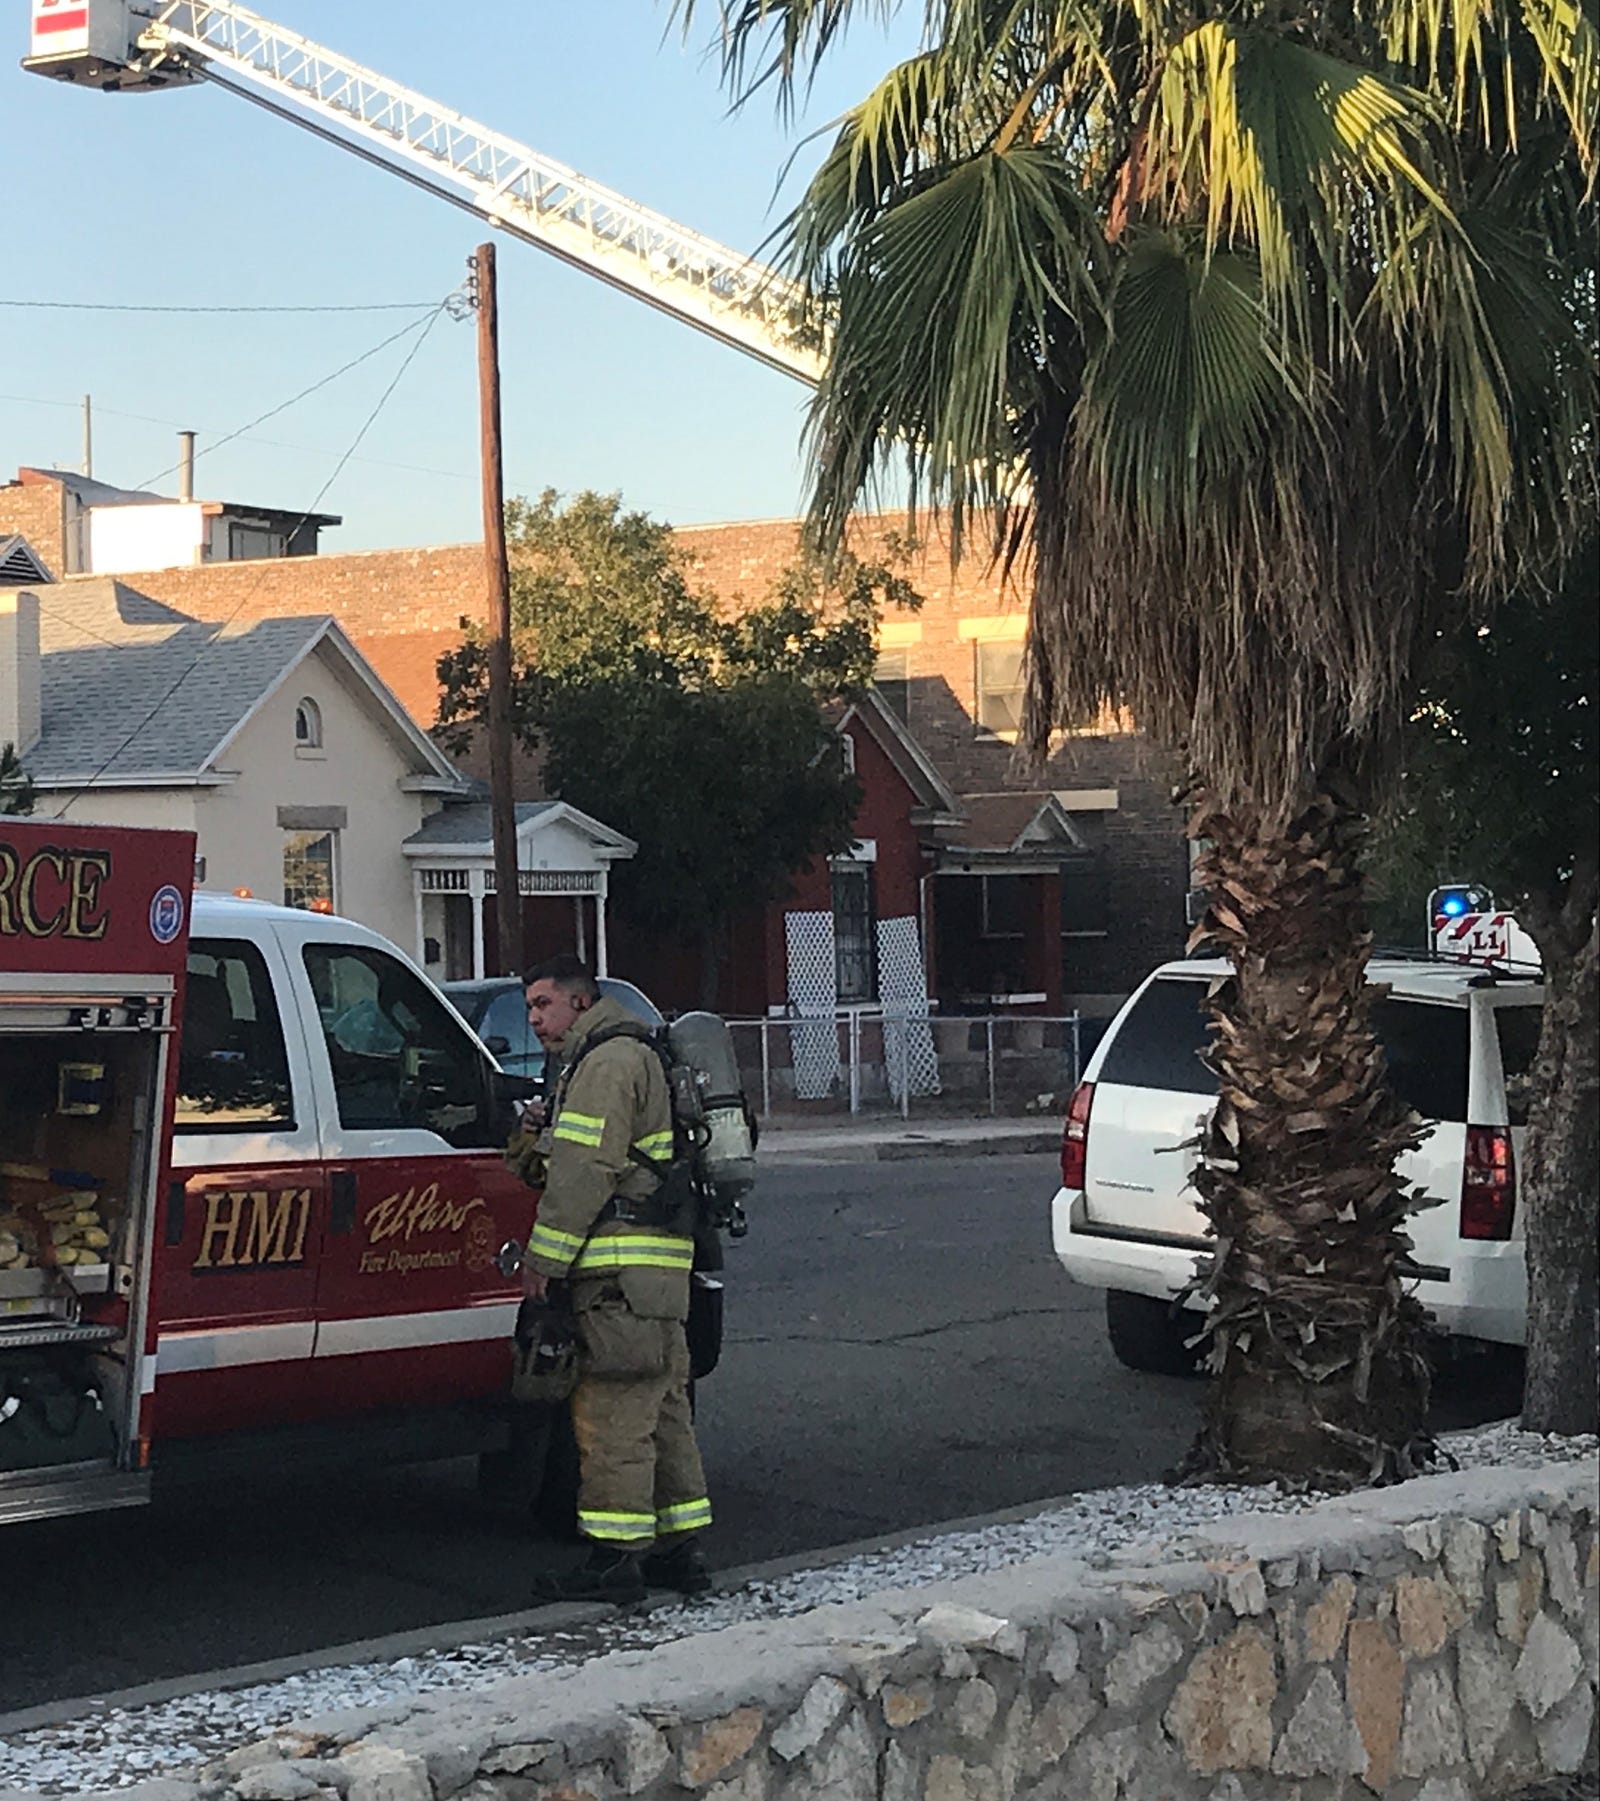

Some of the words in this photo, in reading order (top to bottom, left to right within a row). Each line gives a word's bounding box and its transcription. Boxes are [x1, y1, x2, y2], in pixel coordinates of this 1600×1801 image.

[1472, 931, 1499, 950] L1
[193, 1189, 310, 1268] HM1
[364, 1187, 415, 1243] El
[405, 1182, 486, 1241] Paso
[359, 1252, 386, 1273] Fire
[386, 1249, 461, 1275] Department
